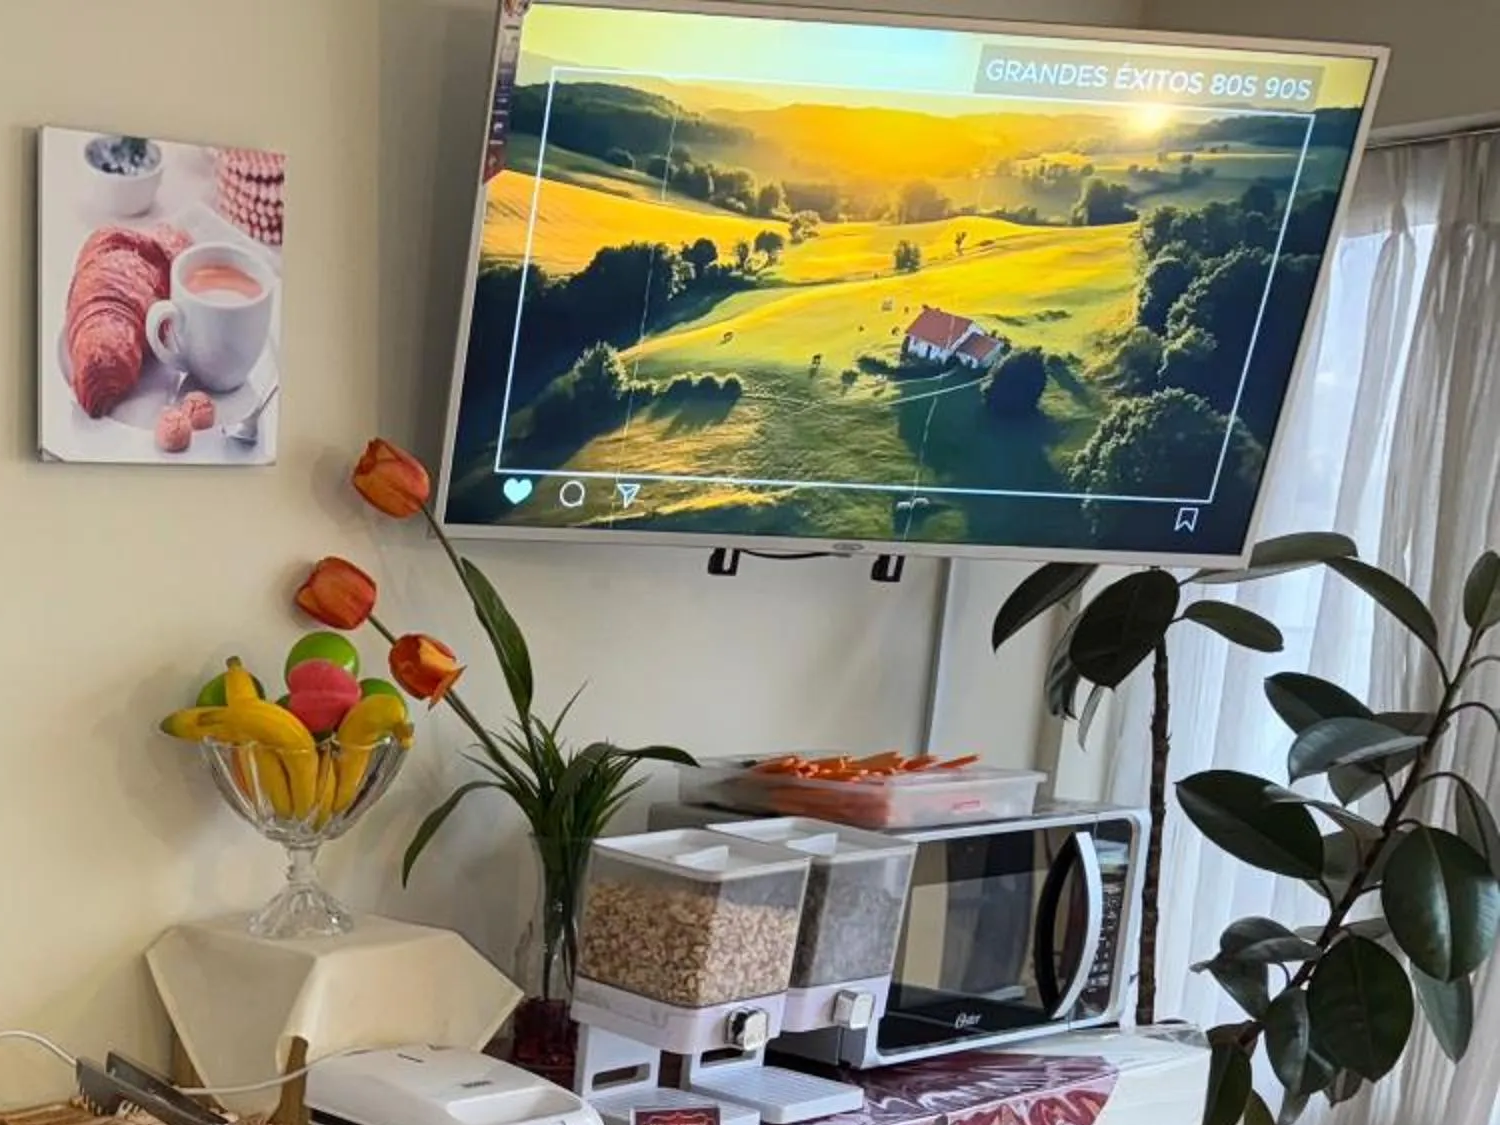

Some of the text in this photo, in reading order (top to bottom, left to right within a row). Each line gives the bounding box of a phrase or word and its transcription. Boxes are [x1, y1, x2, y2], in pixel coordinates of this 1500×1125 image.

[985, 59, 1312, 101] GRANDES ÉXITOS 80S 90S
